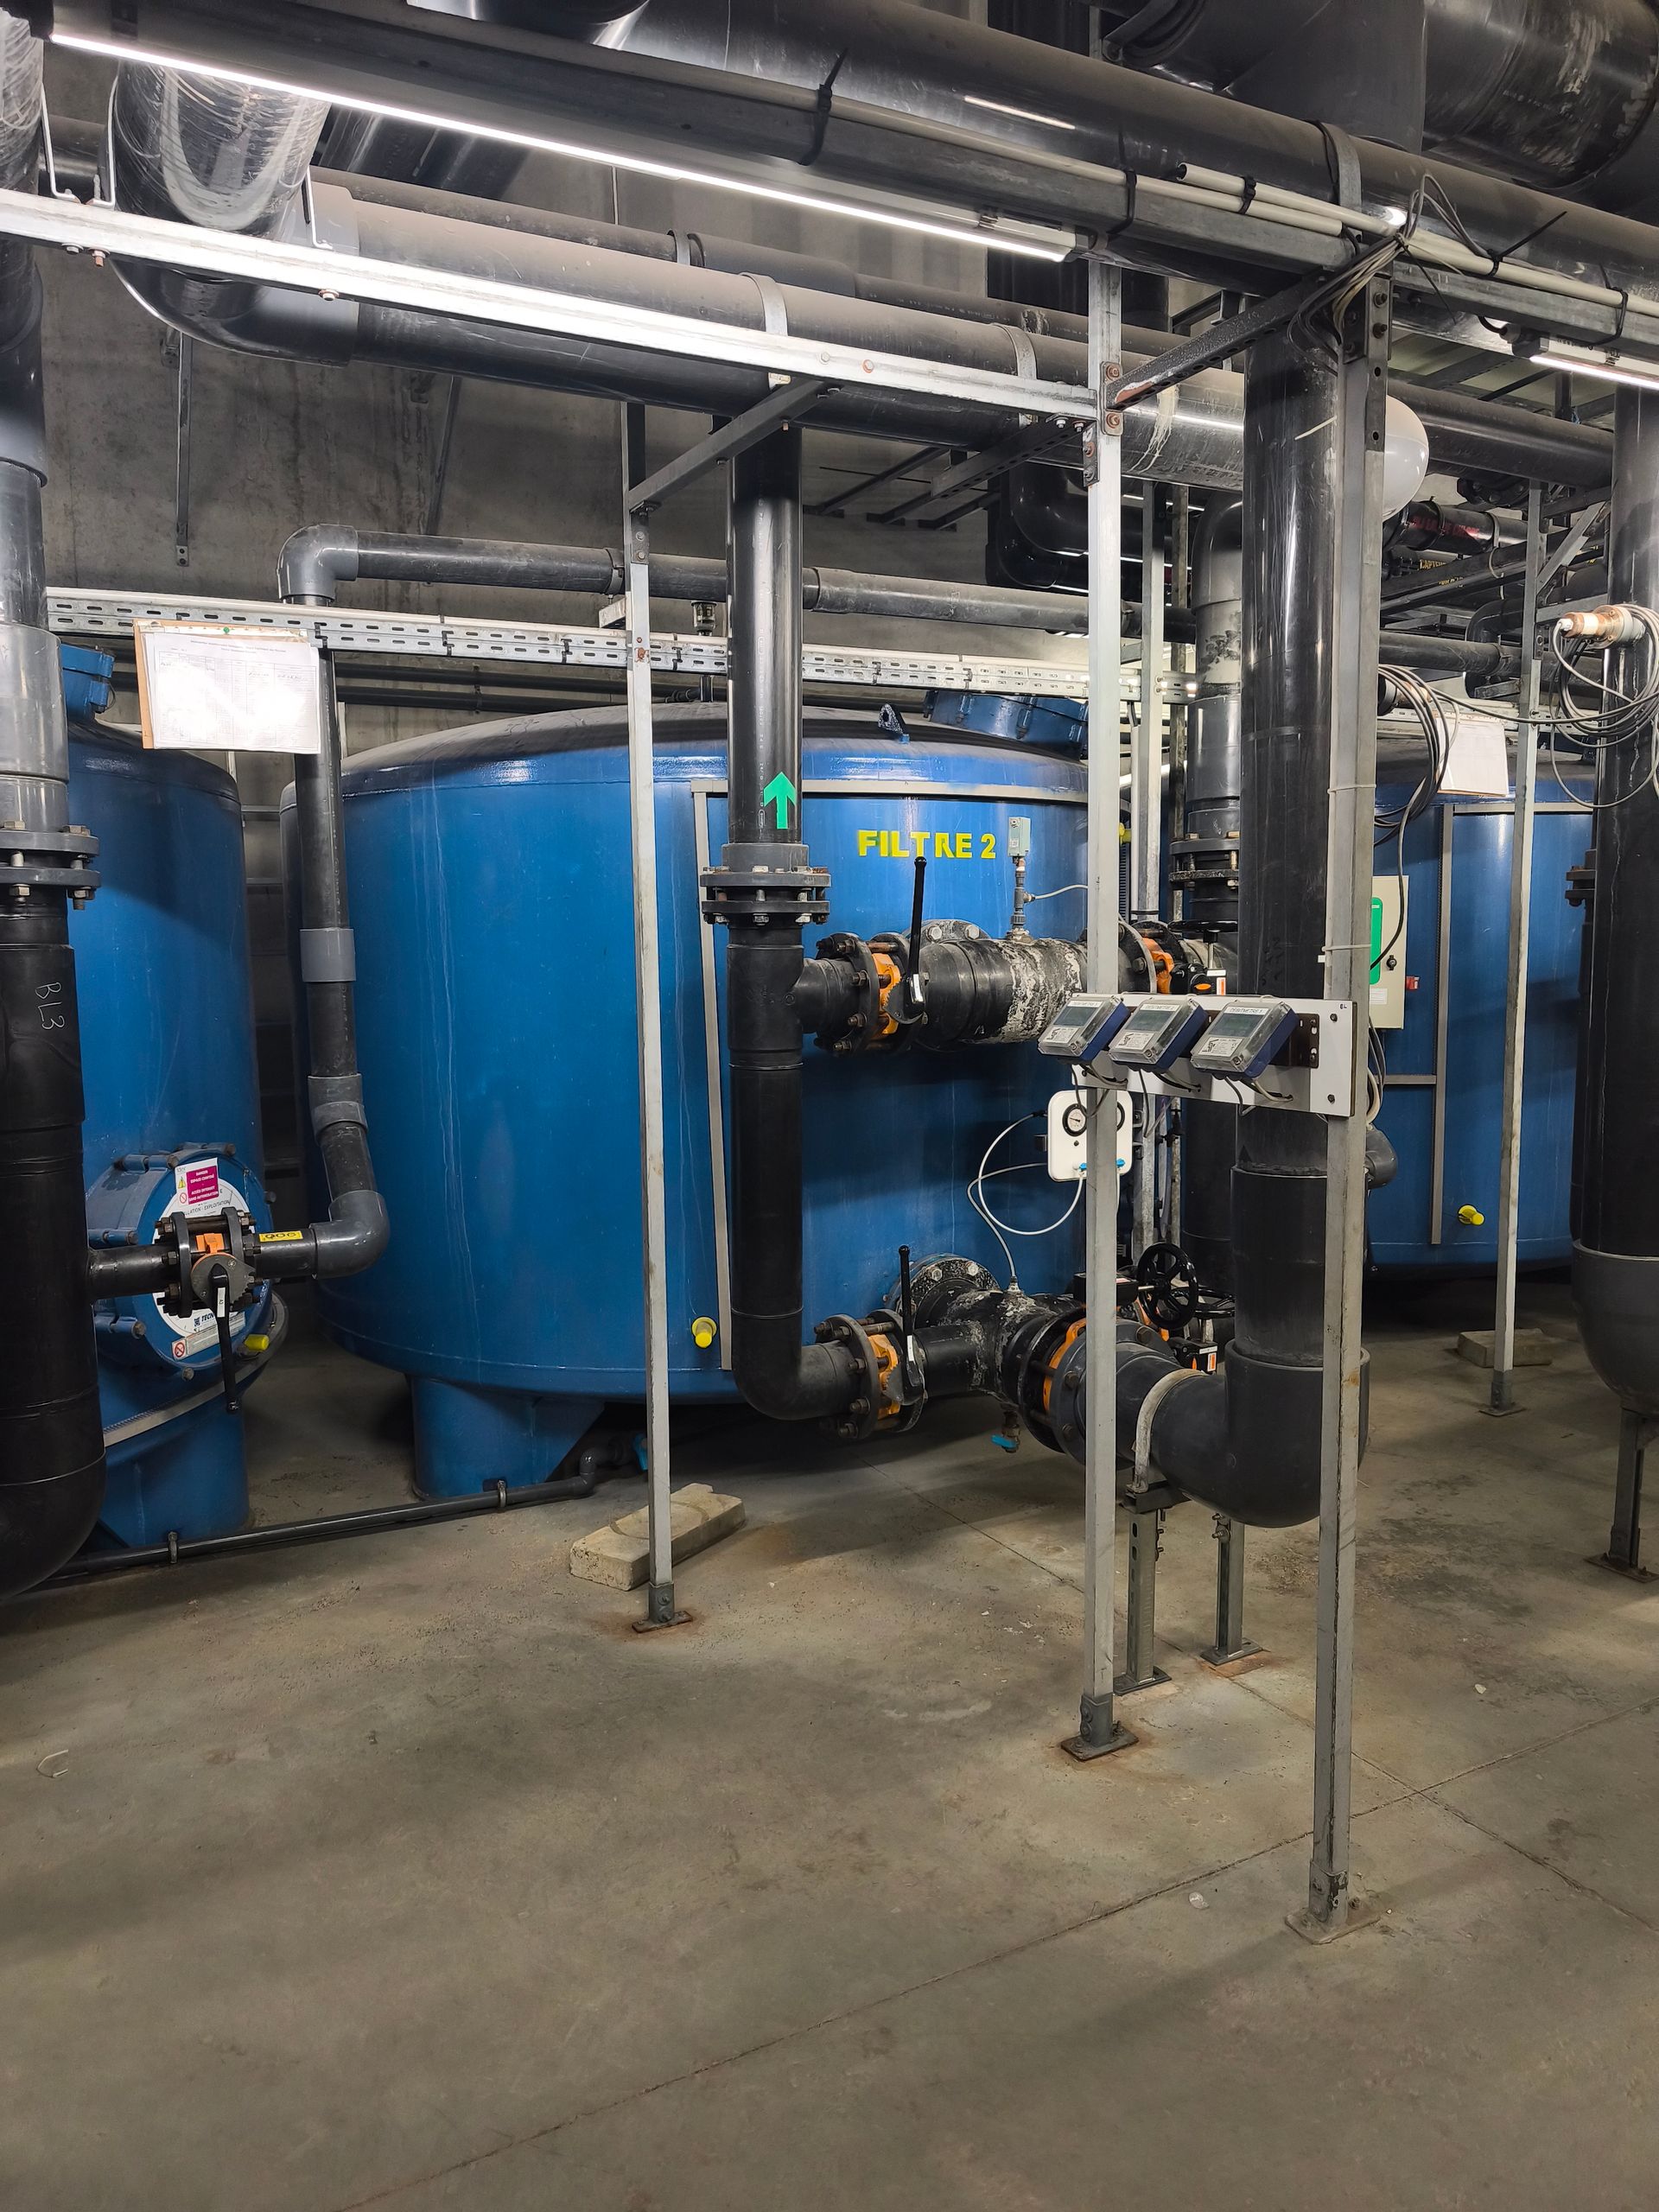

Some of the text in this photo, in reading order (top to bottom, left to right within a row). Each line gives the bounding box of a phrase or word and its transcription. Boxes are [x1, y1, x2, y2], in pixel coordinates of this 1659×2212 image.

[857, 830, 996, 859] FILTRE 2
[35, 982, 65, 1030] BL3
